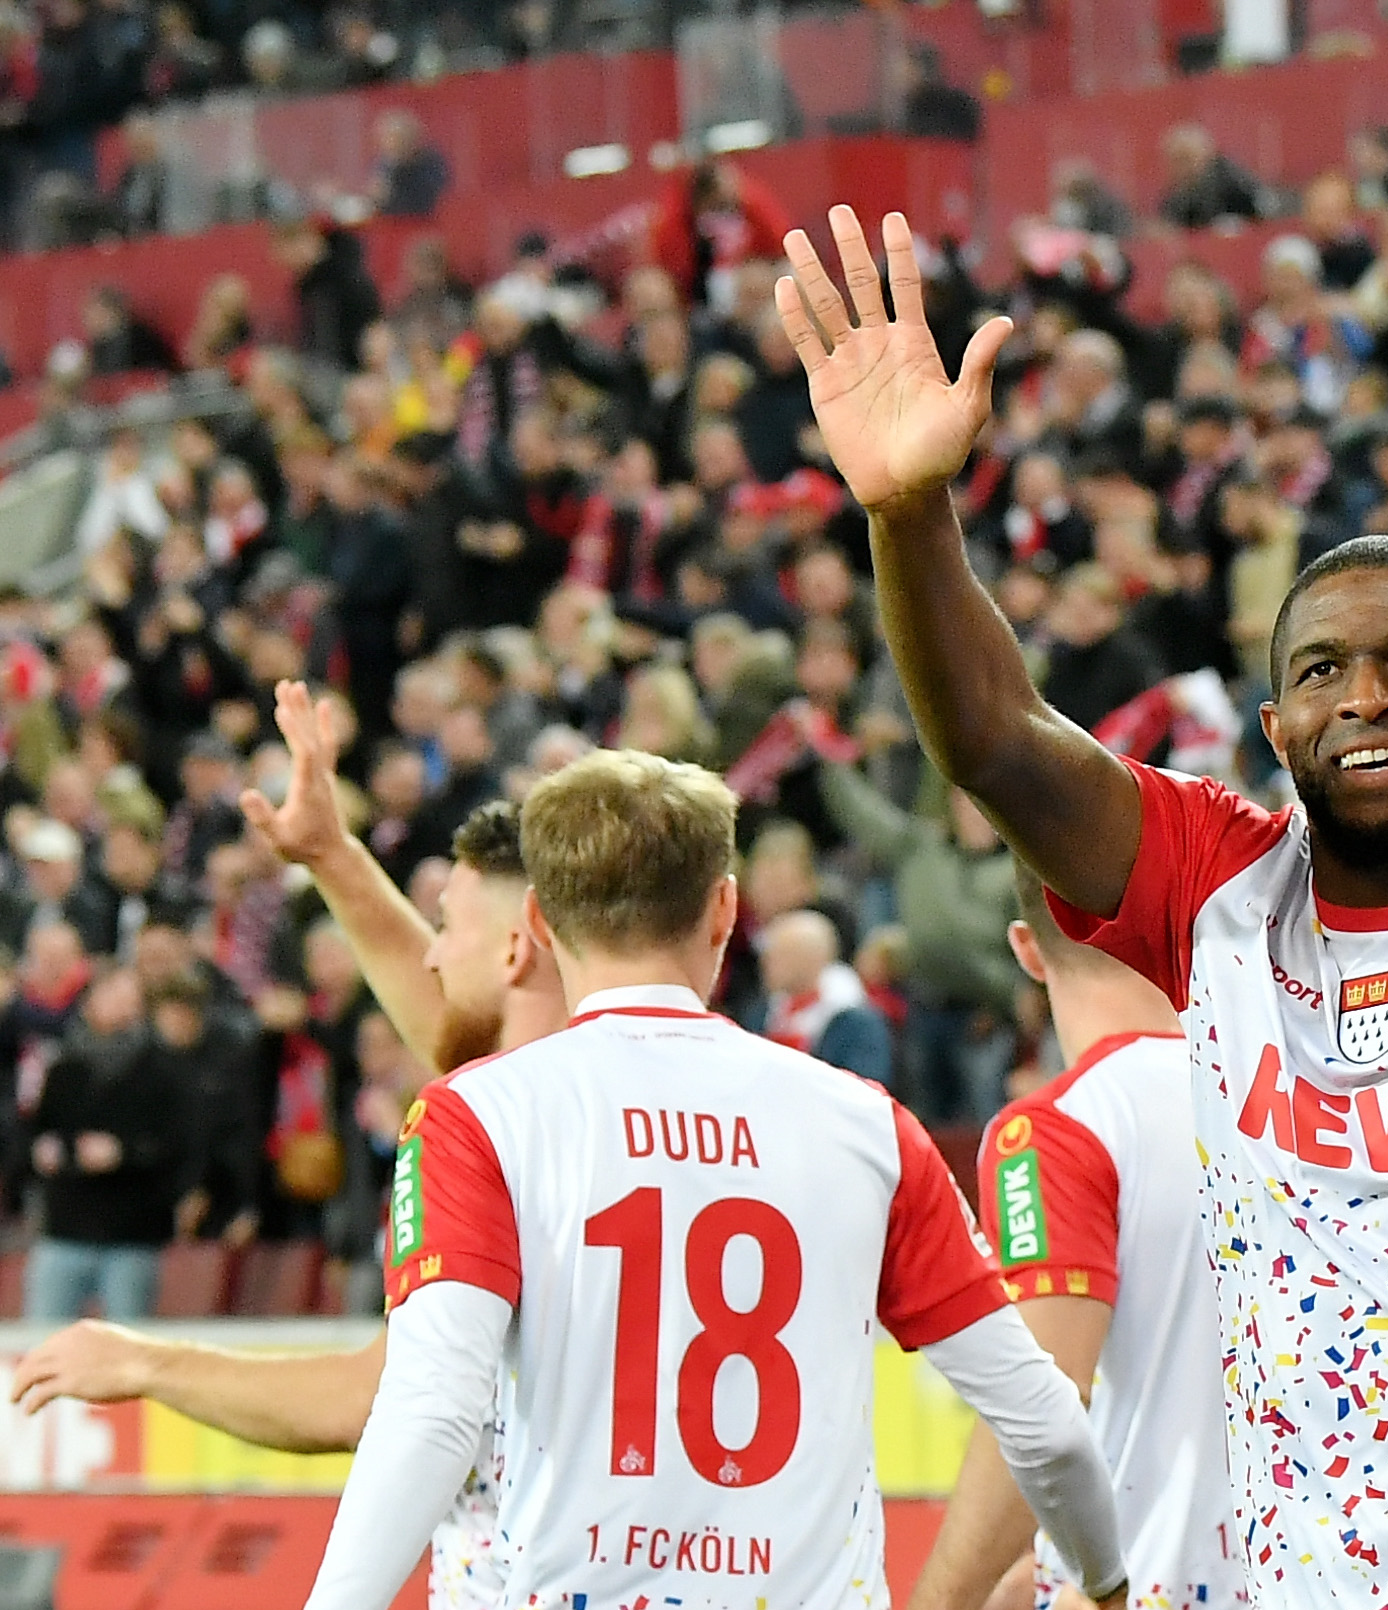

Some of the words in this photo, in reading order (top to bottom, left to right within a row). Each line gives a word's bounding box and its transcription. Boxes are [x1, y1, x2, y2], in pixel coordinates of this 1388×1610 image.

[1269, 954, 1324, 1010] port
[623, 1108, 760, 1169] DUDA
[1004, 1161, 1038, 1259] DEVK
[584, 1187, 802, 1487] 18
[586, 1523, 607, 1563] 1.
